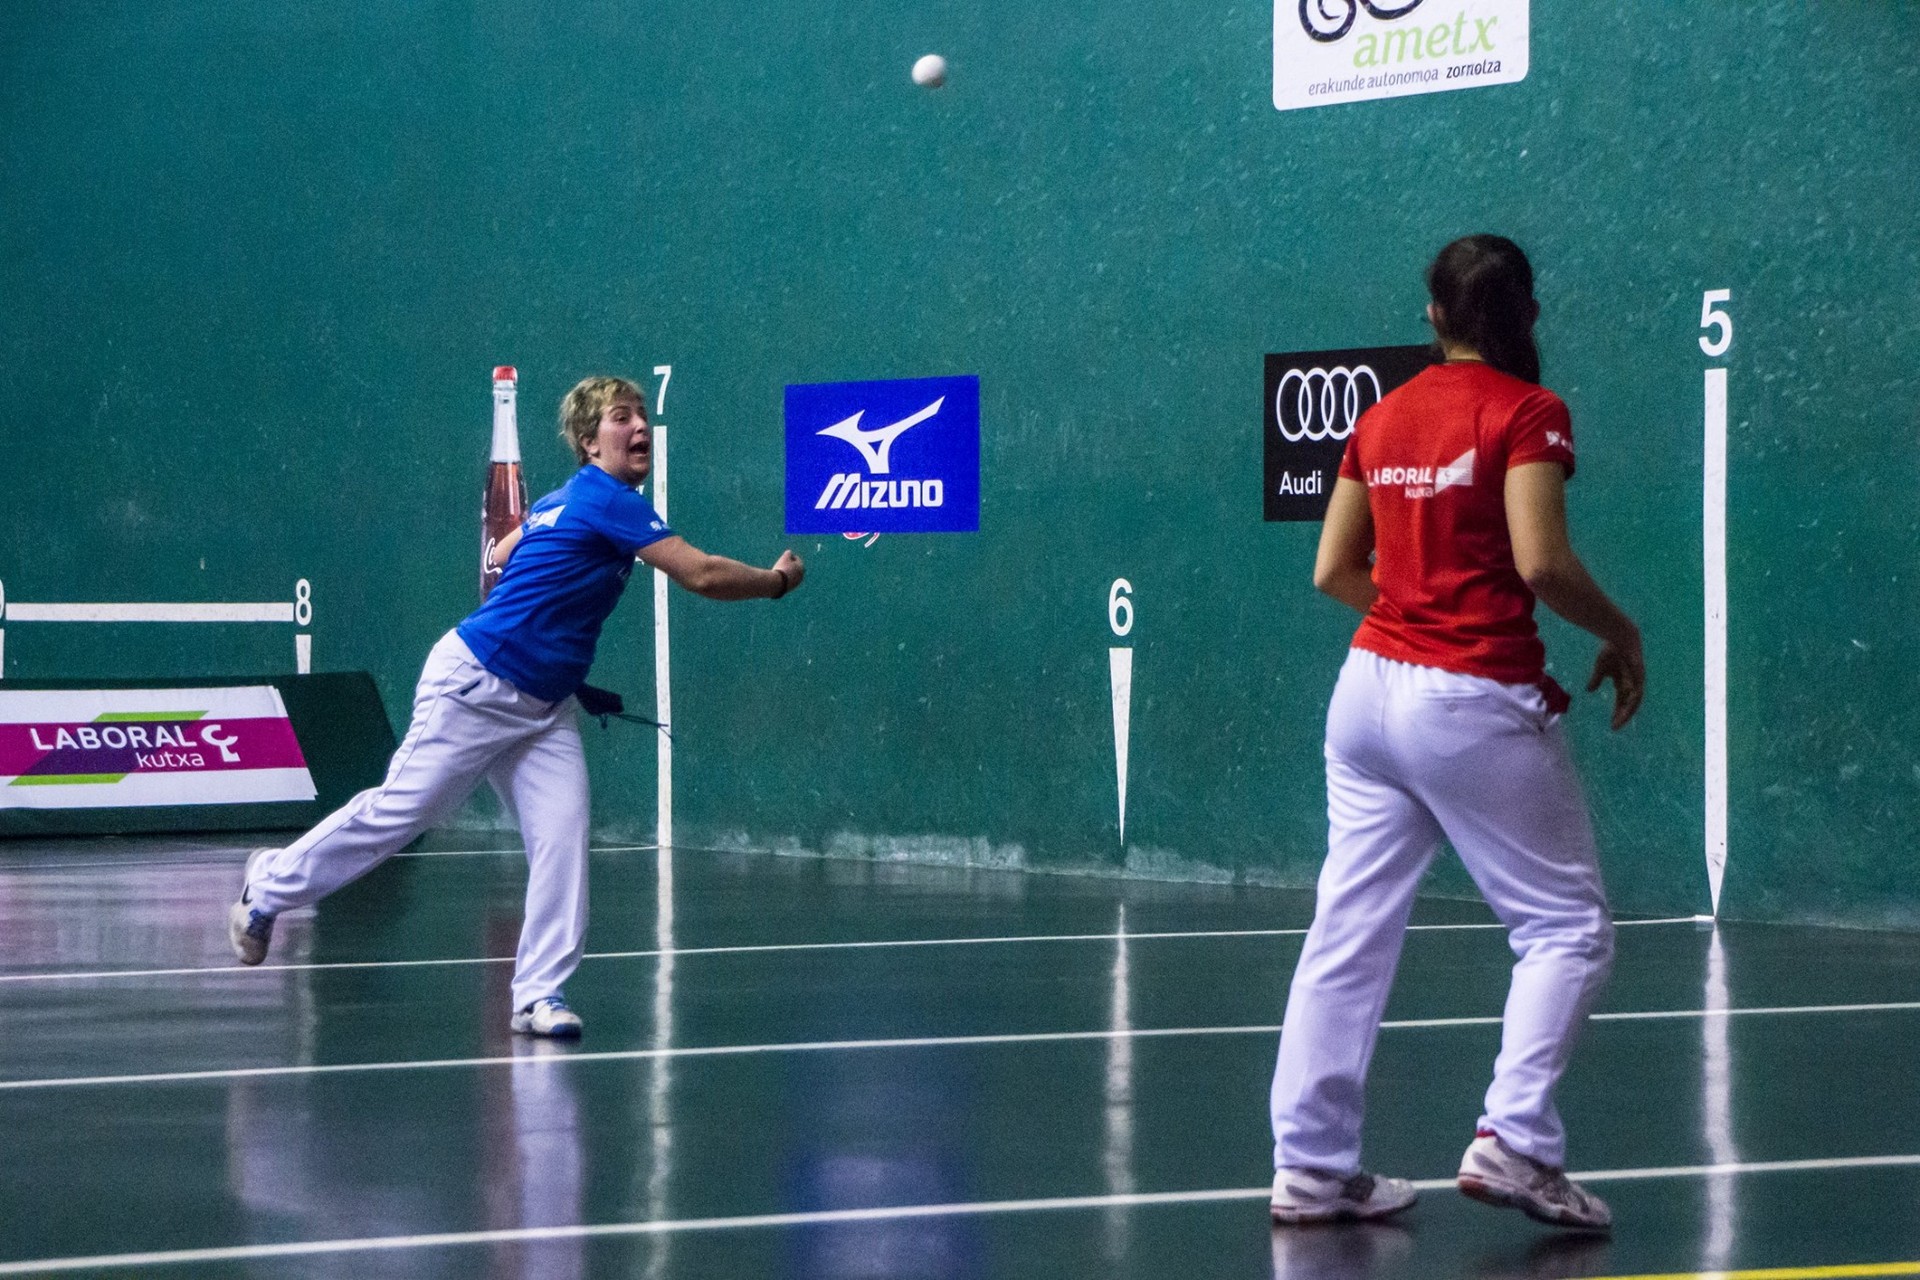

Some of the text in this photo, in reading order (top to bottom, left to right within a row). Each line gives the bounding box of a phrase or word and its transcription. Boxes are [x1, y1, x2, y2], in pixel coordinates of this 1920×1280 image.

[1353, 10, 1498, 68] ametx
[1308, 59, 1501, 96] erakunde autonomoa zornotza
[1699, 288, 1733, 357] 5
[654, 365, 672, 415] 7
[1279, 470, 1322, 495] Audi
[295, 578, 312, 626] 8
[1108, 577, 1134, 637] 6
[30, 725, 198, 751] LABORAL
[135, 751, 206, 769] kutxa
